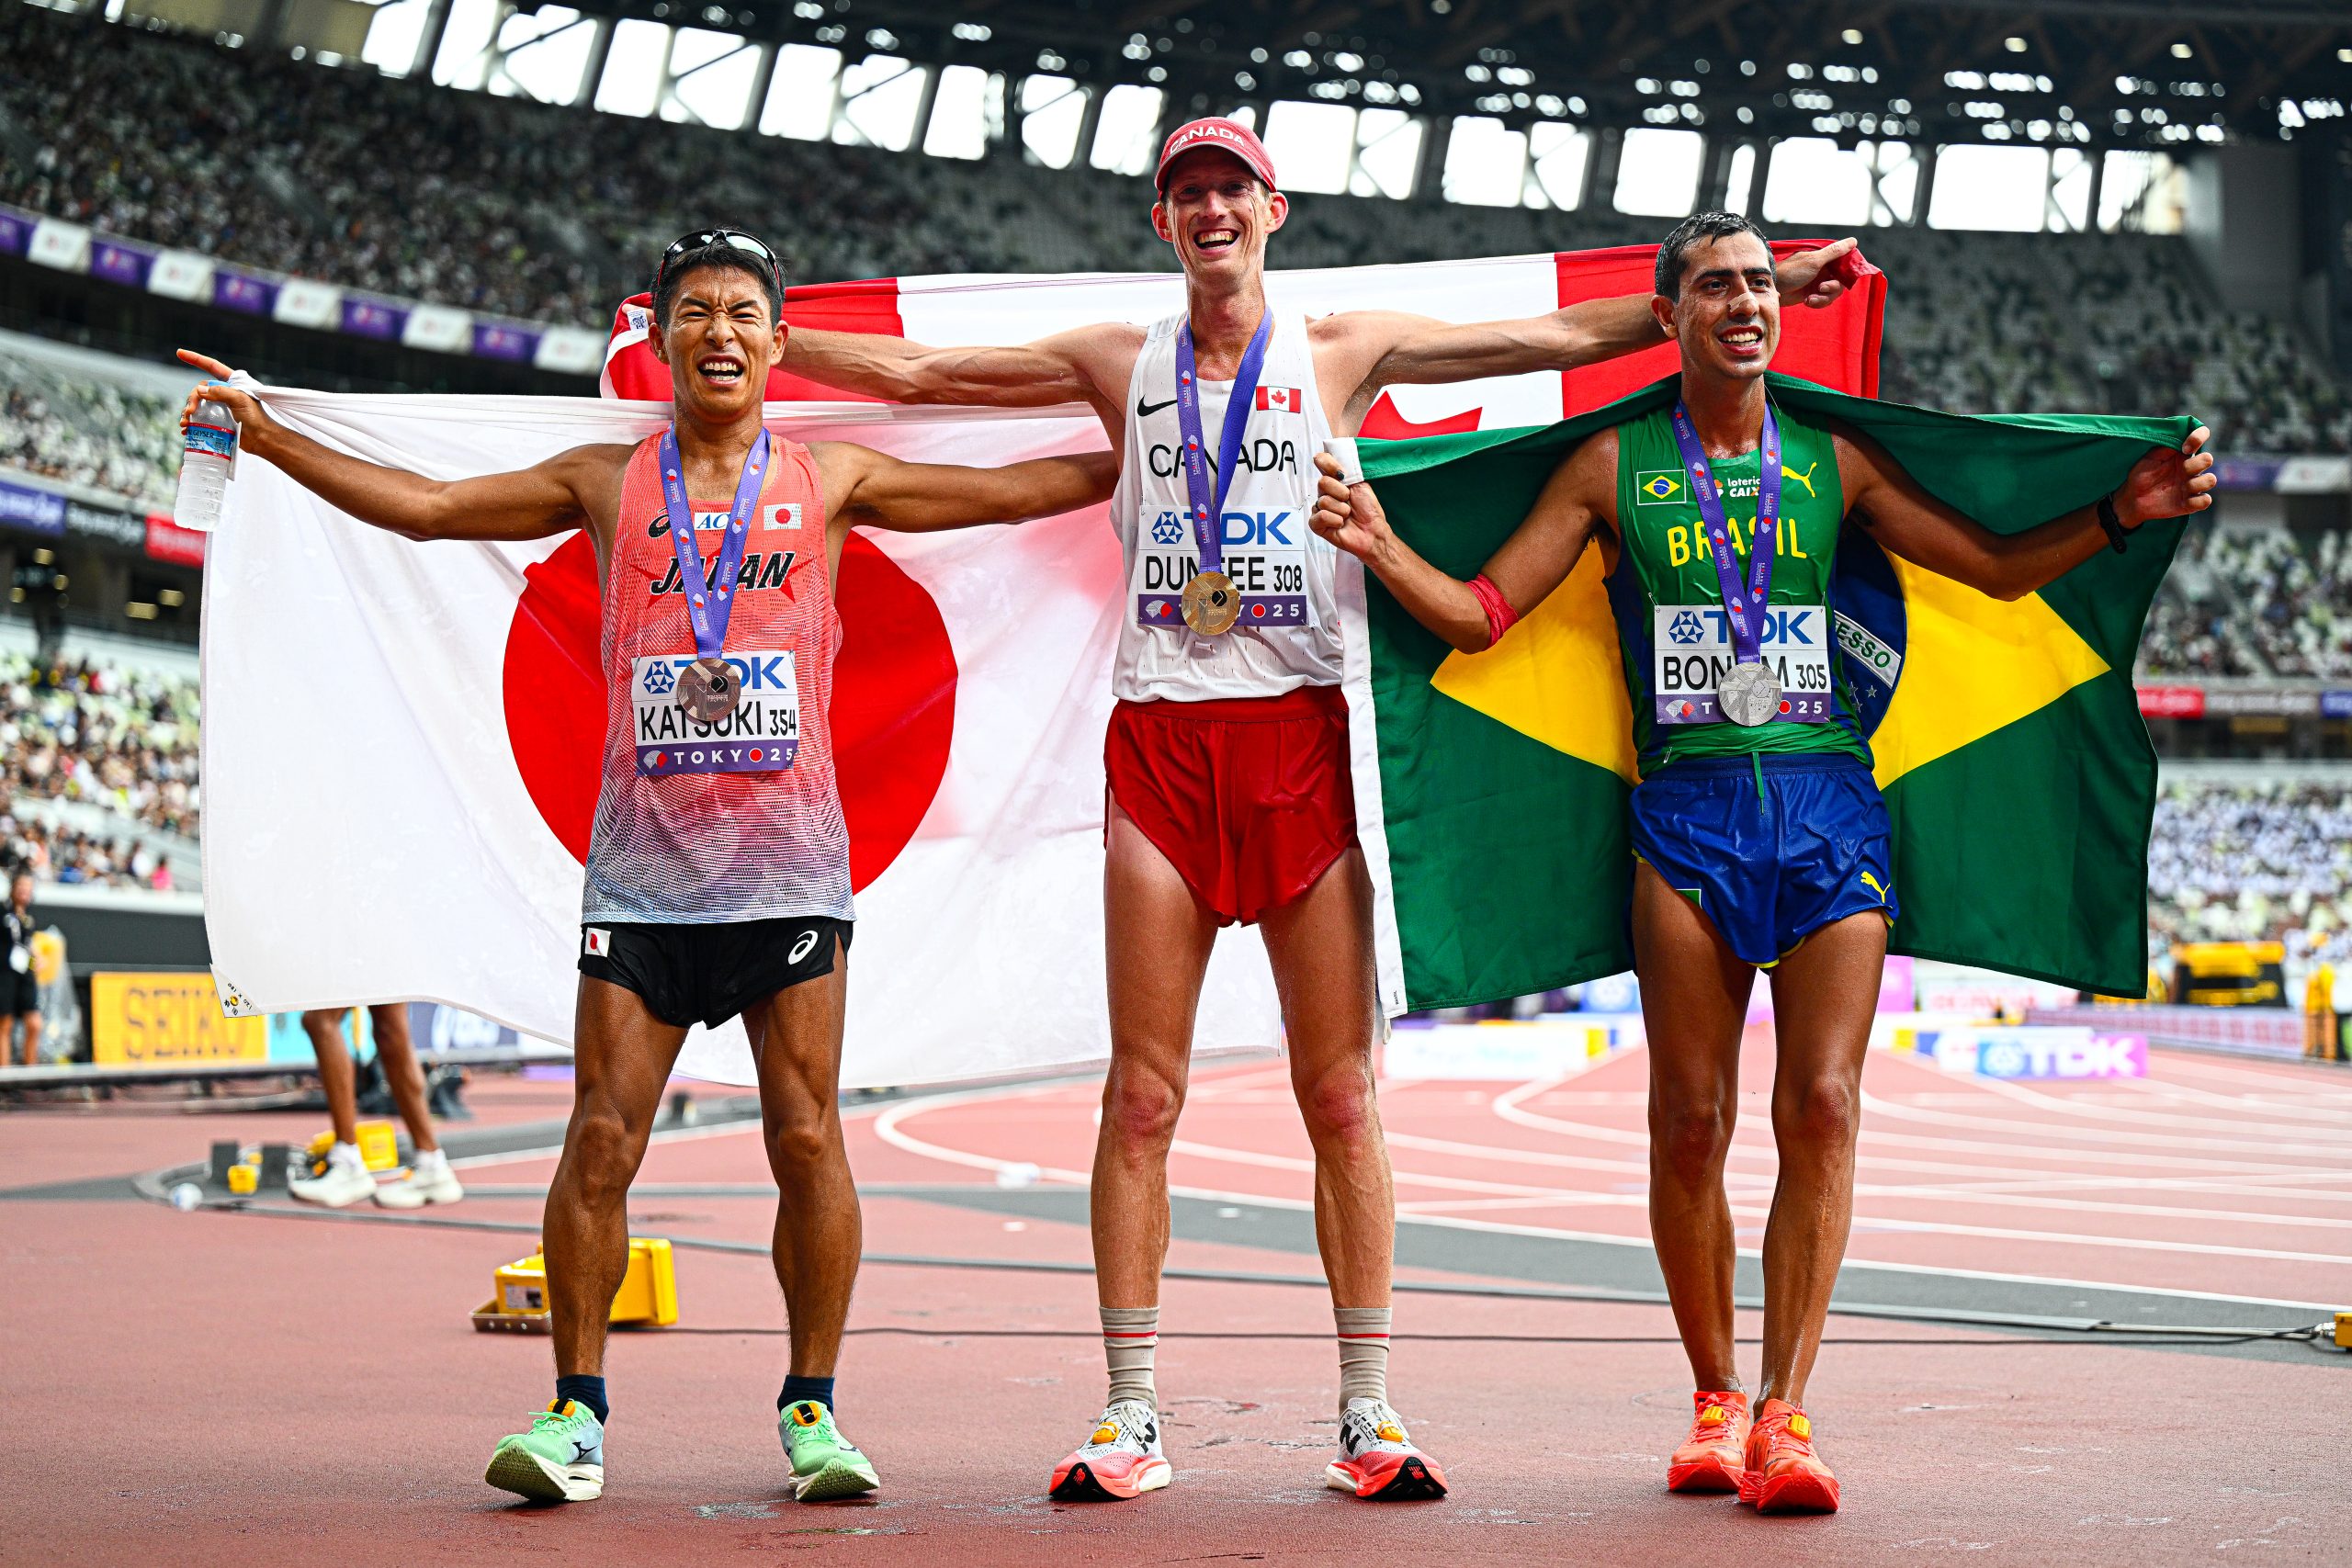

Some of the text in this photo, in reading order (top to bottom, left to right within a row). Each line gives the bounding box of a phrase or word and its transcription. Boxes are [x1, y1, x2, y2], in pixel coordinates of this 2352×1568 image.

[1170, 126, 1245, 154] CANADA
[193, 429, 214, 438] GEYSER
[1727, 476, 1761, 487] loteri
[1729, 486, 1760, 498] CAIX
[697, 513, 731, 529] AC
[1146, 556, 1303, 592] DUNEE 308
[1663, 655, 1827, 690] BONM 305
[770, 709, 797, 737] 354
[2027, 1038, 2136, 1076] TDK
